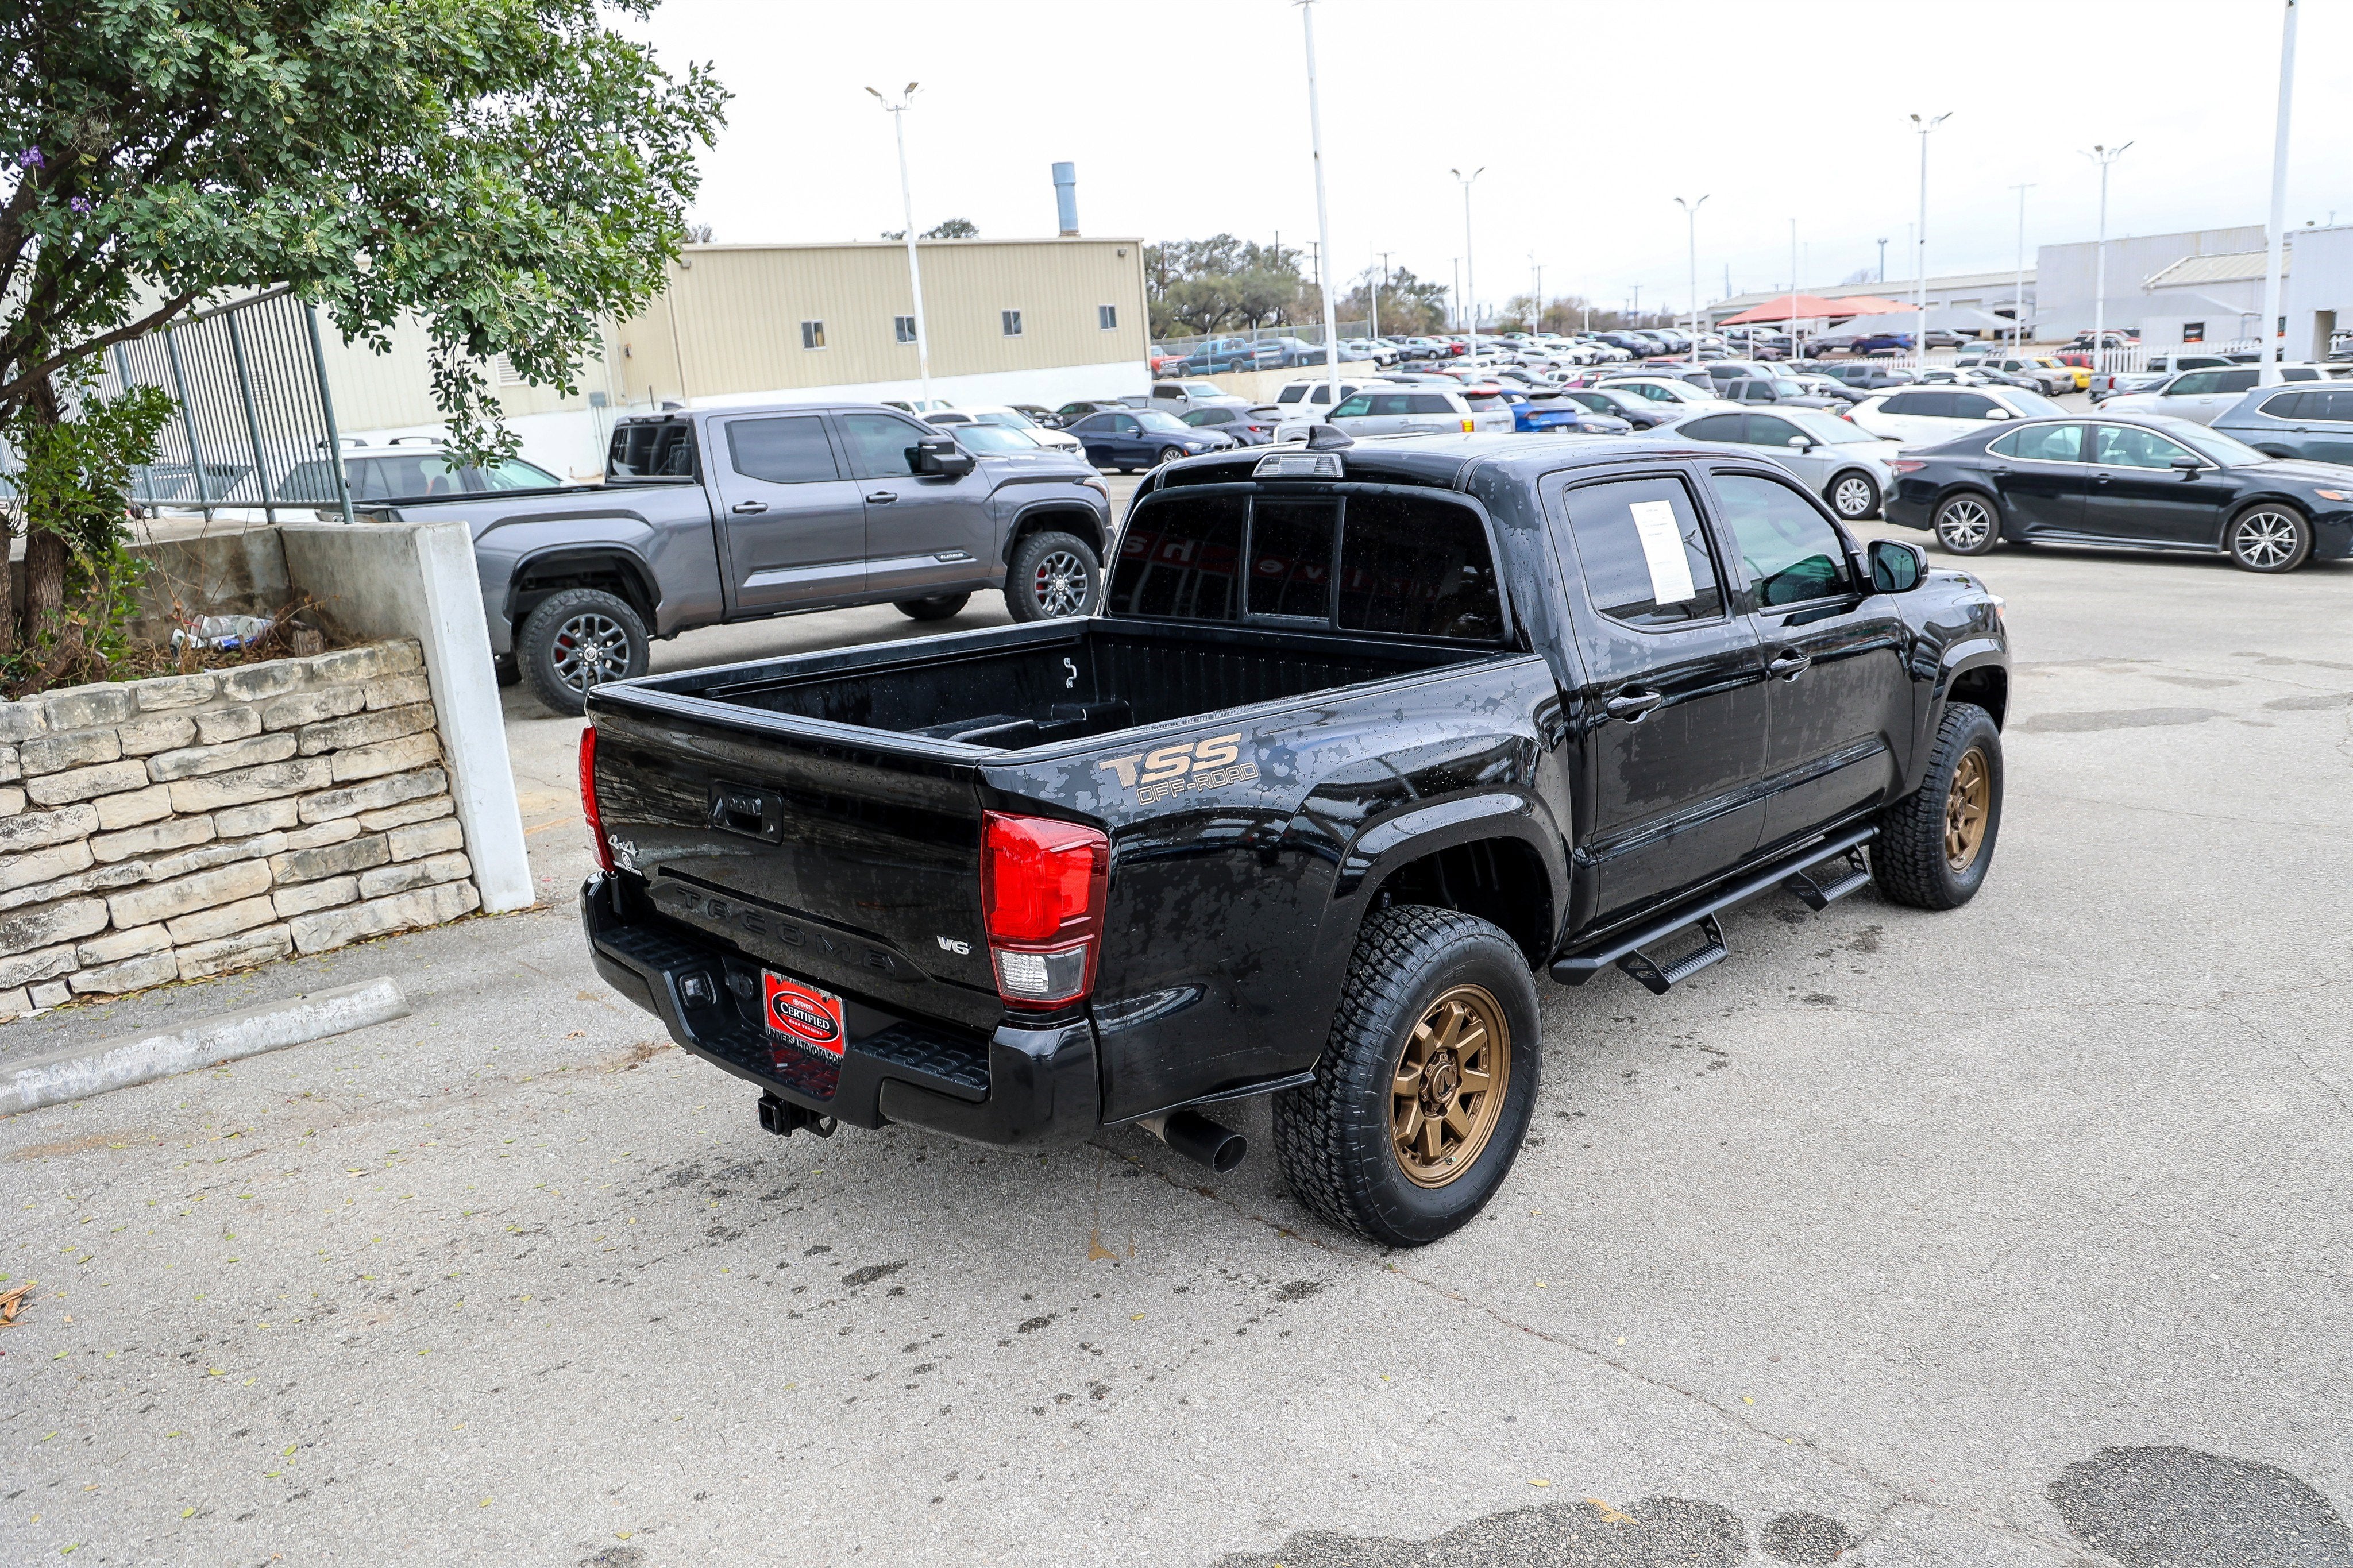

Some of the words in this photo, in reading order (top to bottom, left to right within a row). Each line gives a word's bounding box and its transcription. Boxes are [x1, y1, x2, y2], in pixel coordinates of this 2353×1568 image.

[1099, 732, 1242, 790] TSS
[1136, 762, 1259, 805] OFF-ROAD
[677, 886, 896, 976] TACOMA
[936, 936, 969, 955] V6
[780, 1002, 830, 1030] CERTIFIED
[799, 1001, 813, 1011] TOYOTA
